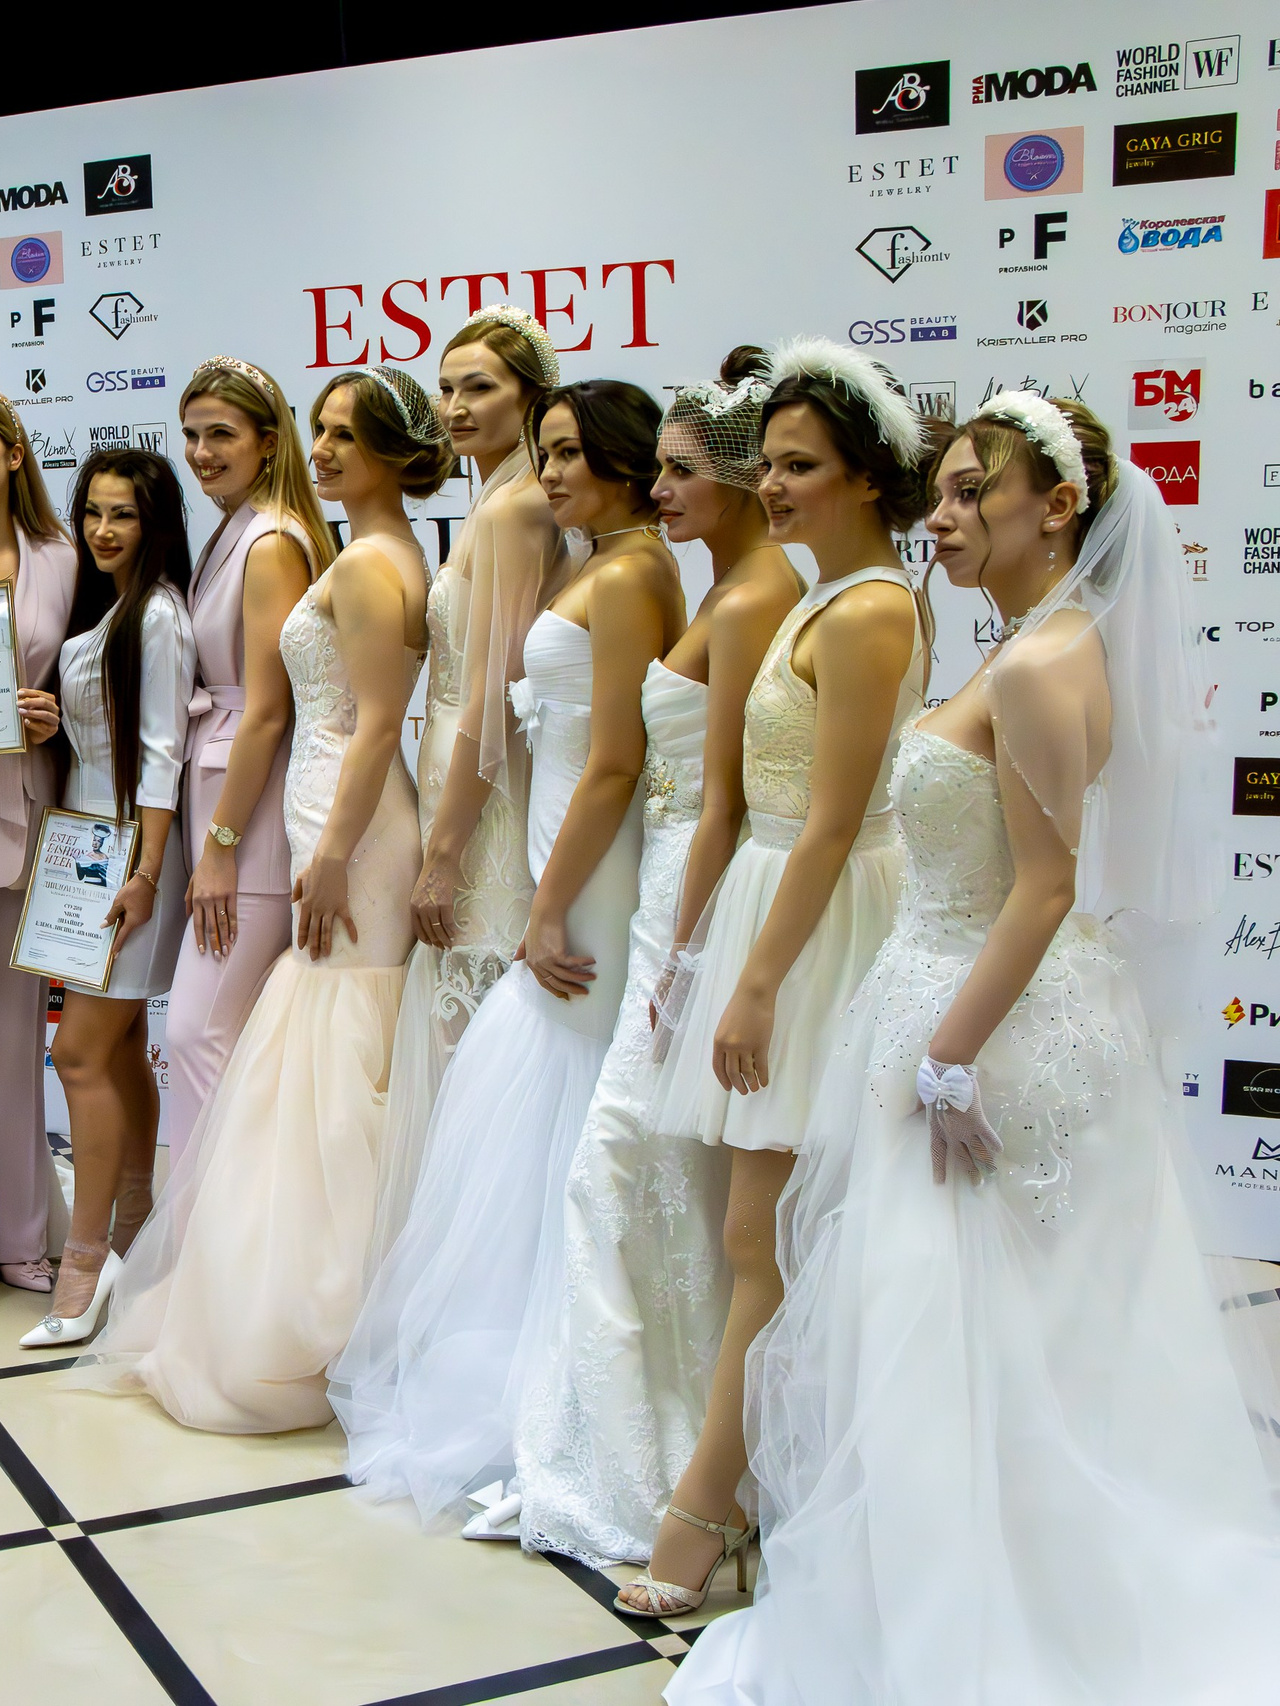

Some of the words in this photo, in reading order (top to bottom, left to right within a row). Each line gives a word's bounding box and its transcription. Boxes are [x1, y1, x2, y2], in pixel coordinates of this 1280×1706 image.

[1116, 44, 1180, 67] WORLD
[1192, 47, 1233, 78] WF
[984, 62, 1097, 103] MODA
[1116, 63, 1180, 83] FASHION
[1116, 79, 1180, 98] CHANNEL
[1126, 136, 1172, 153] GAYA
[1177, 130, 1223, 147] GRIG
[848, 155, 959, 183] ESTET
[869, 185, 932, 198] JEWELRY
[1140, 215, 1226, 230] Королевская
[81, 233, 162, 257] ESTET
[998, 228, 1015, 249] P
[1034, 211, 1068, 260] F
[1140, 225, 1223, 249] ВОДА
[886, 232, 951, 270] fashiontv
[97, 257, 143, 269] JEWELRY
[998, 264, 1048, 274] PROFASHION
[10, 311, 22, 328] P
[33, 298, 56, 337] F
[303, 259, 676, 370] ESTET
[910, 315, 957, 325] BEAUTY
[1112, 299, 1227, 324] BONJOUR
[848, 318, 906, 346] GSS
[918, 329, 949, 338] LAB
[1164, 321, 1227, 335] magazine
[976, 335, 1056, 347] KRISTALLER
[1060, 333, 1088, 343] PRO
[131, 367, 165, 376] BEAUTY
[86, 370, 129, 393] GSS
[136, 378, 161, 387] LAB
[55, 395, 74, 403] PRO
[89, 425, 129, 441] WORLD
[1235, 621, 1275, 632] TOP
[49, 832, 81, 846] ESTET
[44, 854, 72, 869] WEEK
